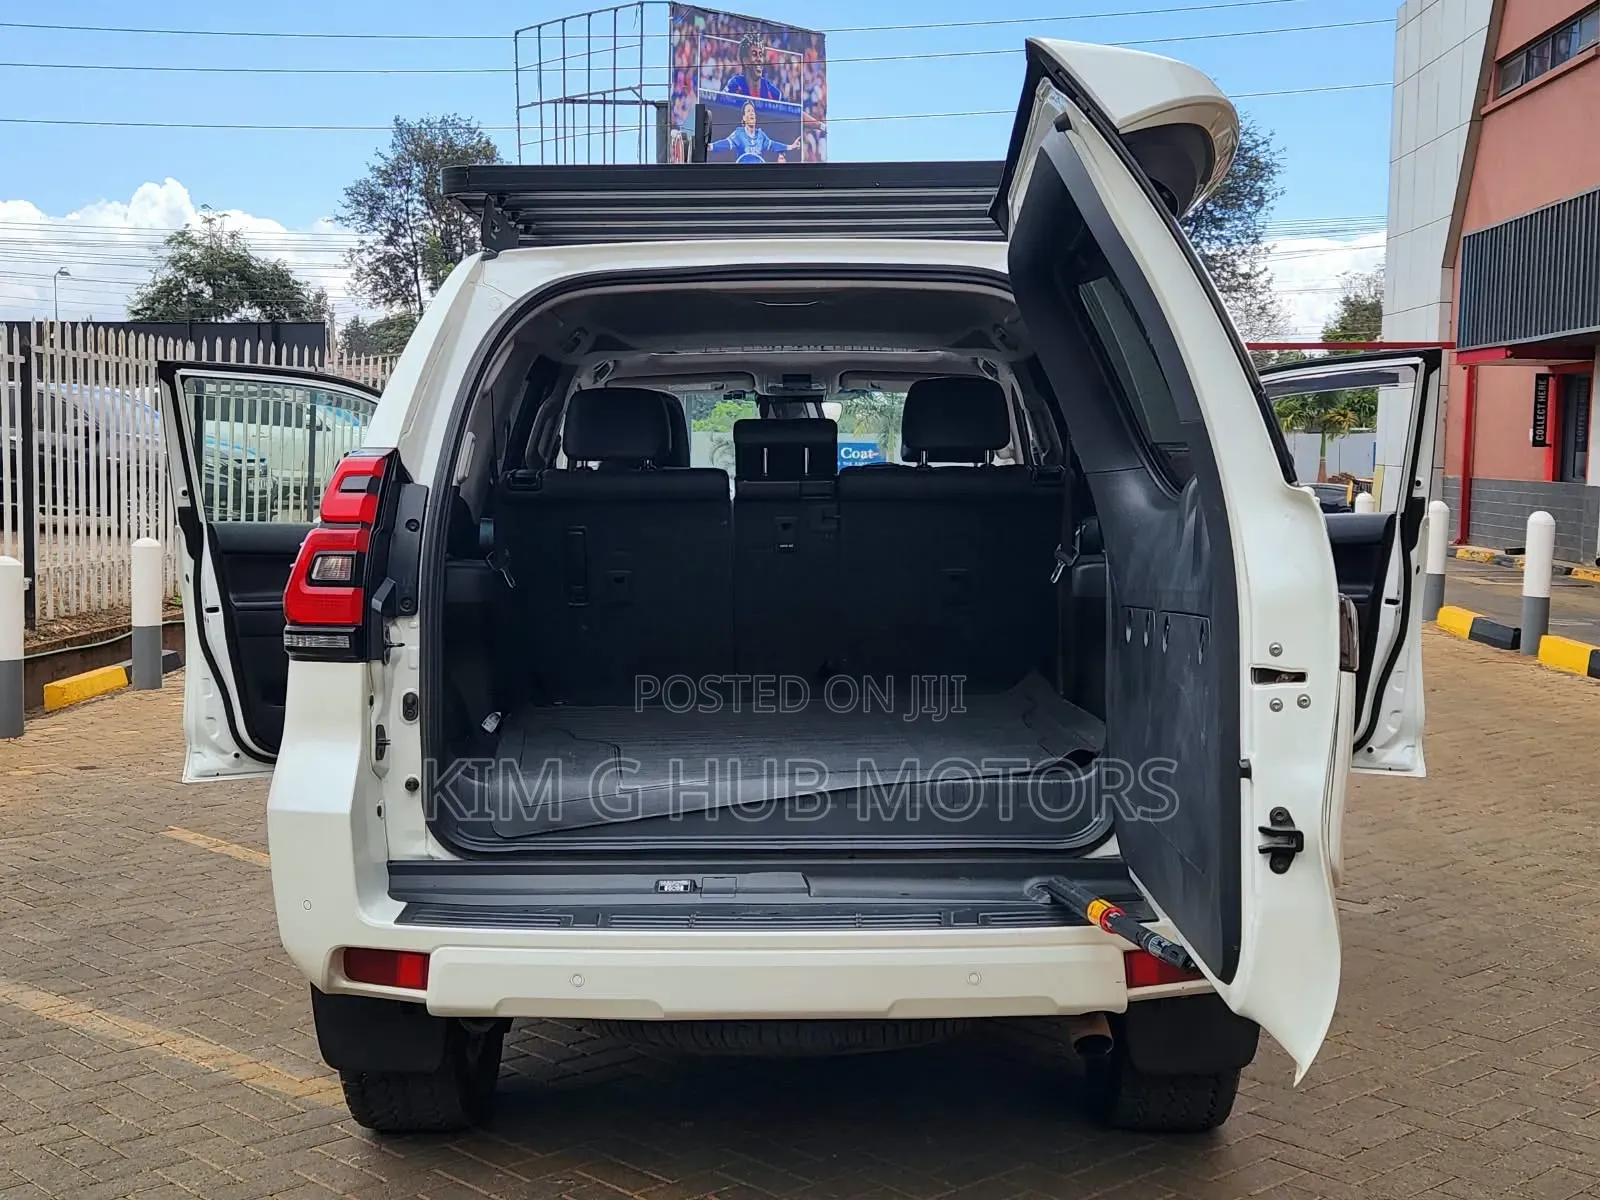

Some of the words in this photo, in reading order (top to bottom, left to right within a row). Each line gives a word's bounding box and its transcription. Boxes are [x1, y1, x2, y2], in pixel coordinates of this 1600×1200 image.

[1537, 379, 1548, 402] HERE
[1535, 403, 1546, 441] COLLECT
[840, 447, 874, 460] Coat
